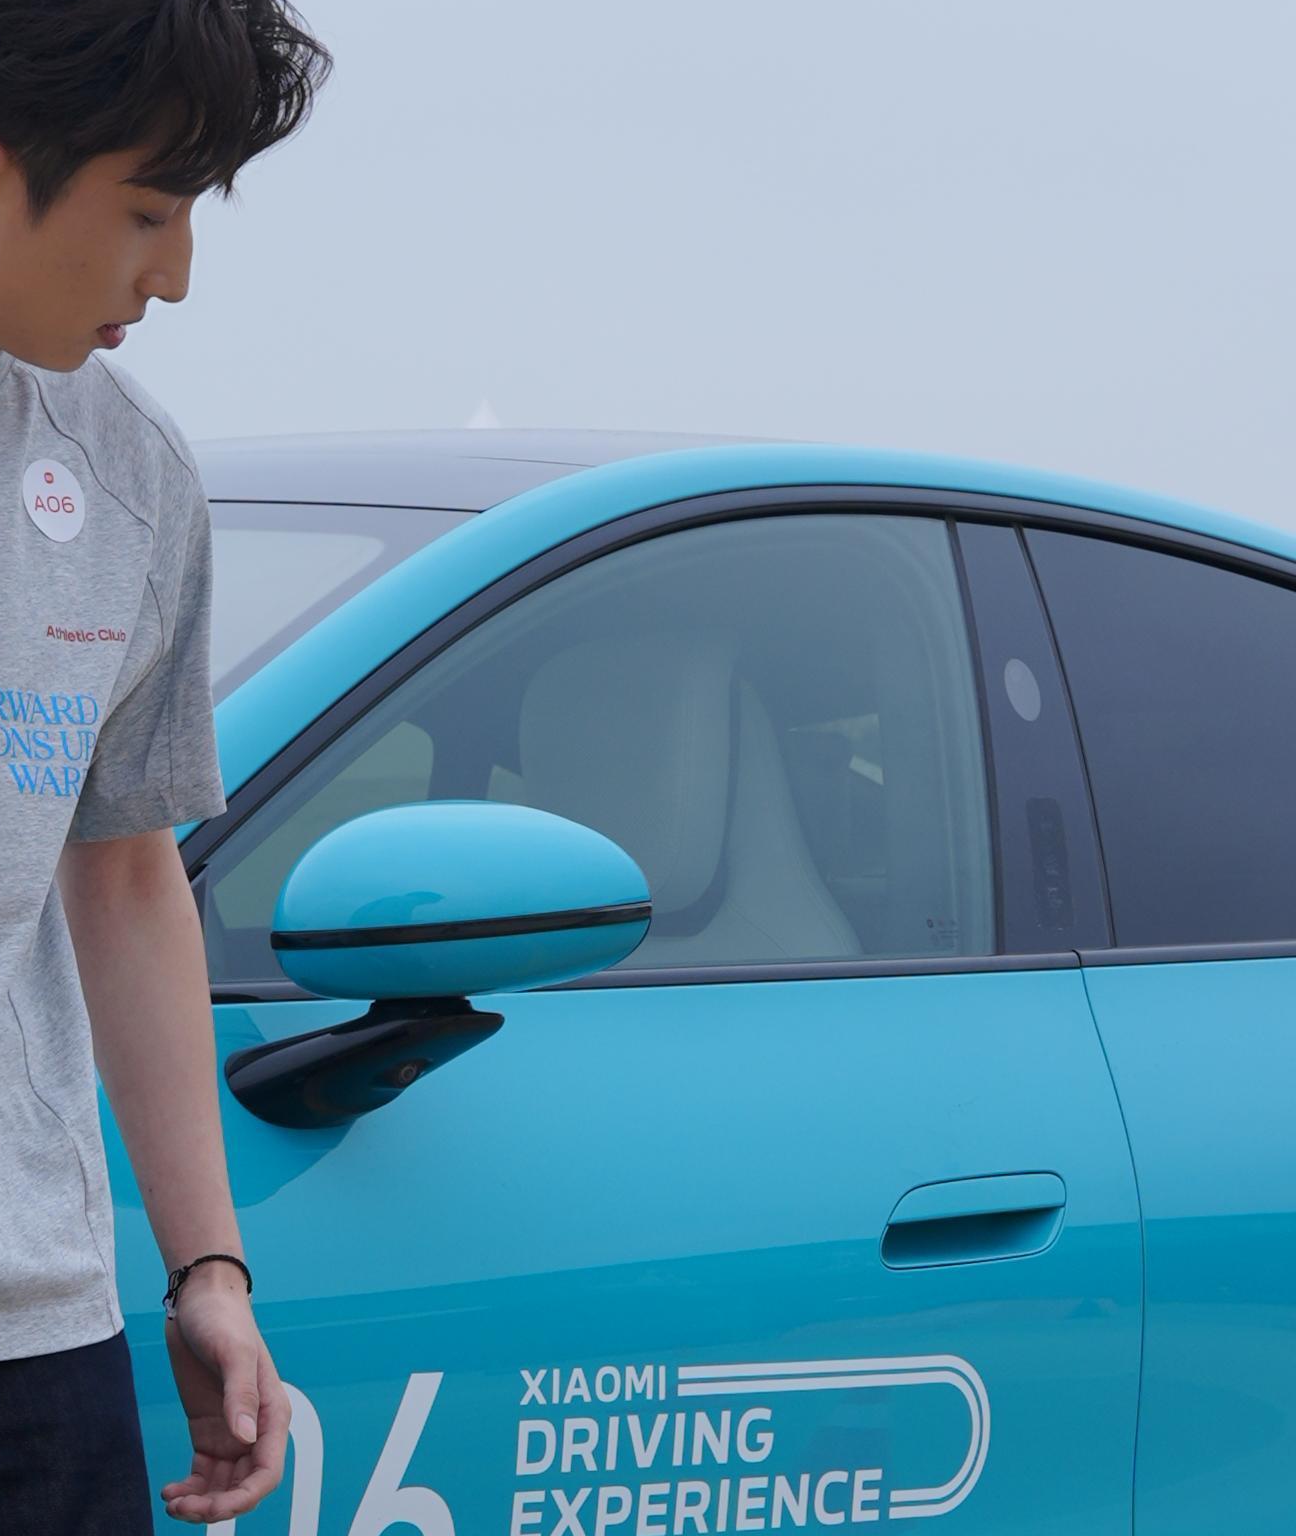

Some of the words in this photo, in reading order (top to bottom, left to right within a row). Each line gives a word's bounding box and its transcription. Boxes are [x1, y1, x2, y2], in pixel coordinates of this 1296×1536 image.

[34, 494, 75, 514] A06
[46, 625, 96, 643] Athletic
[97, 629, 127, 643] Club
[8, 763, 88, 799] WAR
[519, 1365, 667, 1406] XIAOMI
[515, 1407, 775, 1476] DRIVING
